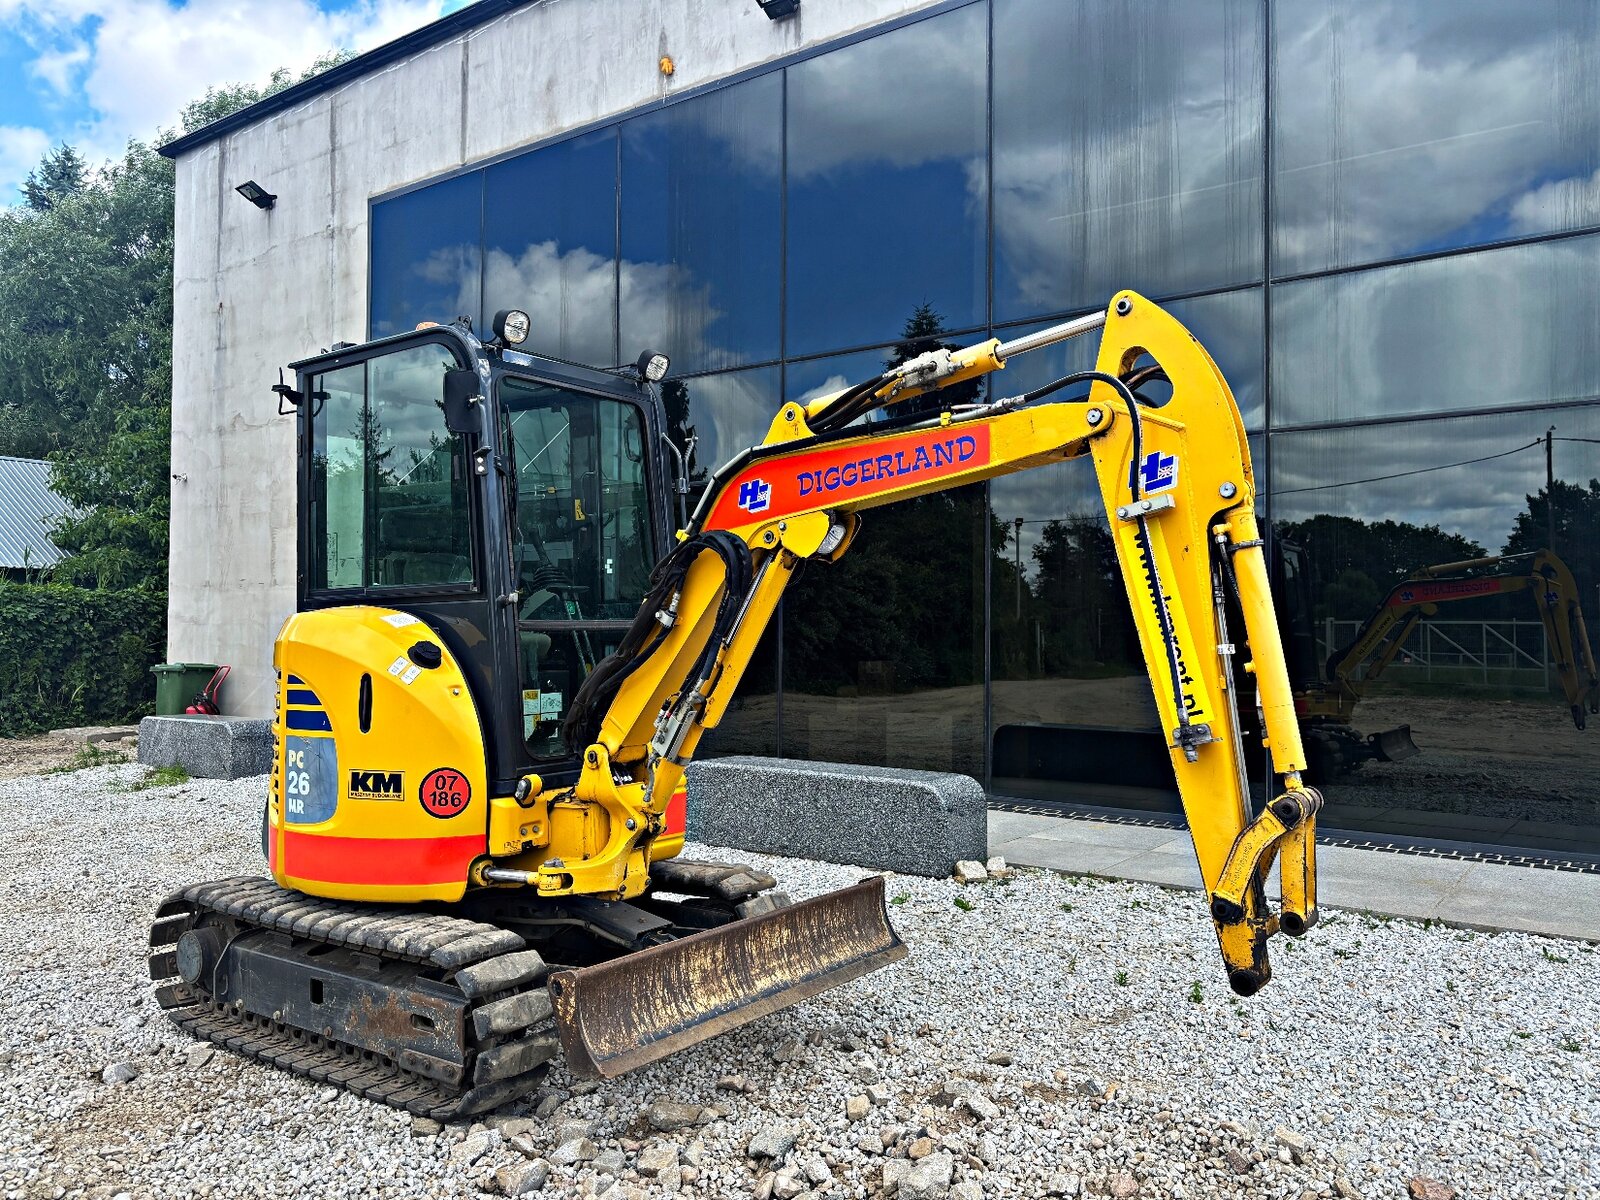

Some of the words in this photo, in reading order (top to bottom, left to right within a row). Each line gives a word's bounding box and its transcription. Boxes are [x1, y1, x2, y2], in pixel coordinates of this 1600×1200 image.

[797, 435, 977, 497] DIGGERLAND
[1134, 532, 1203, 717] kmrentpl
[288, 749, 305, 769] PC
[287, 771, 311, 795] 26
[351, 771, 402, 793] KM
[434, 775, 459, 791] 07
[288, 798, 305, 814] MR
[429, 791, 462, 808] 186
